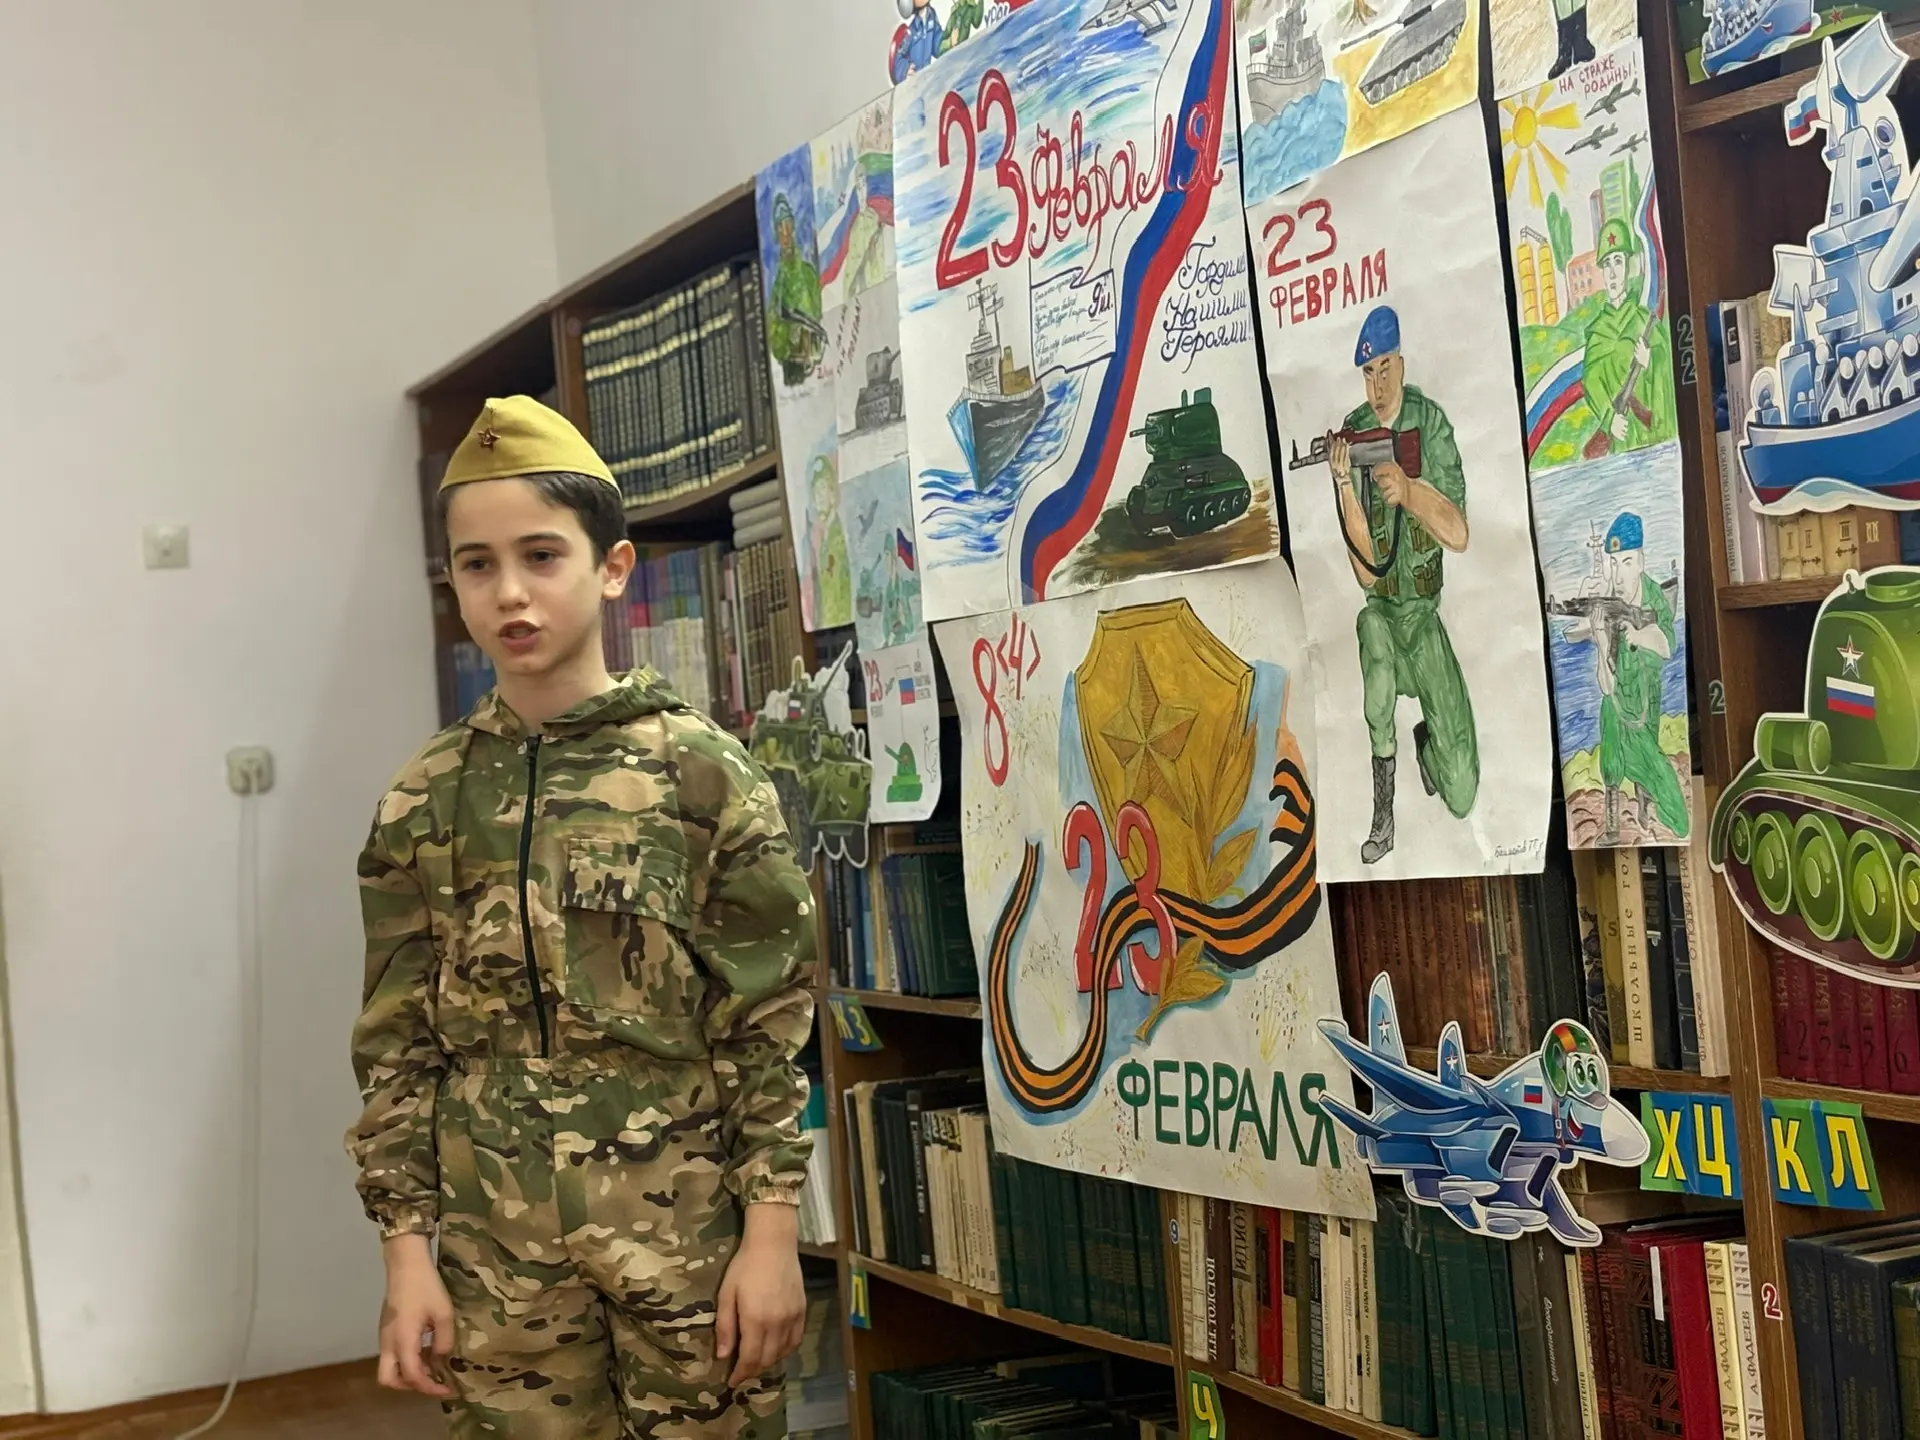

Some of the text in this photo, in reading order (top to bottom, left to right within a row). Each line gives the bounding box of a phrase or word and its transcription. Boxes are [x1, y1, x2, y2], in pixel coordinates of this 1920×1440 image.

[1559, 53, 1615, 95] НА СТРАЖЕ
[1584, 51, 1638, 100] РОДИНЫ!
[935, 68, 1030, 291] 23
[1262, 198, 1338, 279] 23
[1269, 247, 1388, 329] ФЕВРАЛЯ
[1708, 679, 1725, 714] 2
[1062, 800, 1180, 996] 23
[1624, 907, 1643, 1042] ШКОЛЬНЫЕ
[1117, 1058, 1342, 1169] ФЕВРАЛЯ
[1651, 1103, 1733, 1198] Х Ц
[1769, 1113, 1873, 1194] К Л
[1170, 1219, 1180, 1245] 9
[1761, 1282, 1783, 1321] 2
[1740, 1310, 1756, 1376] ФАДЕЕВ
